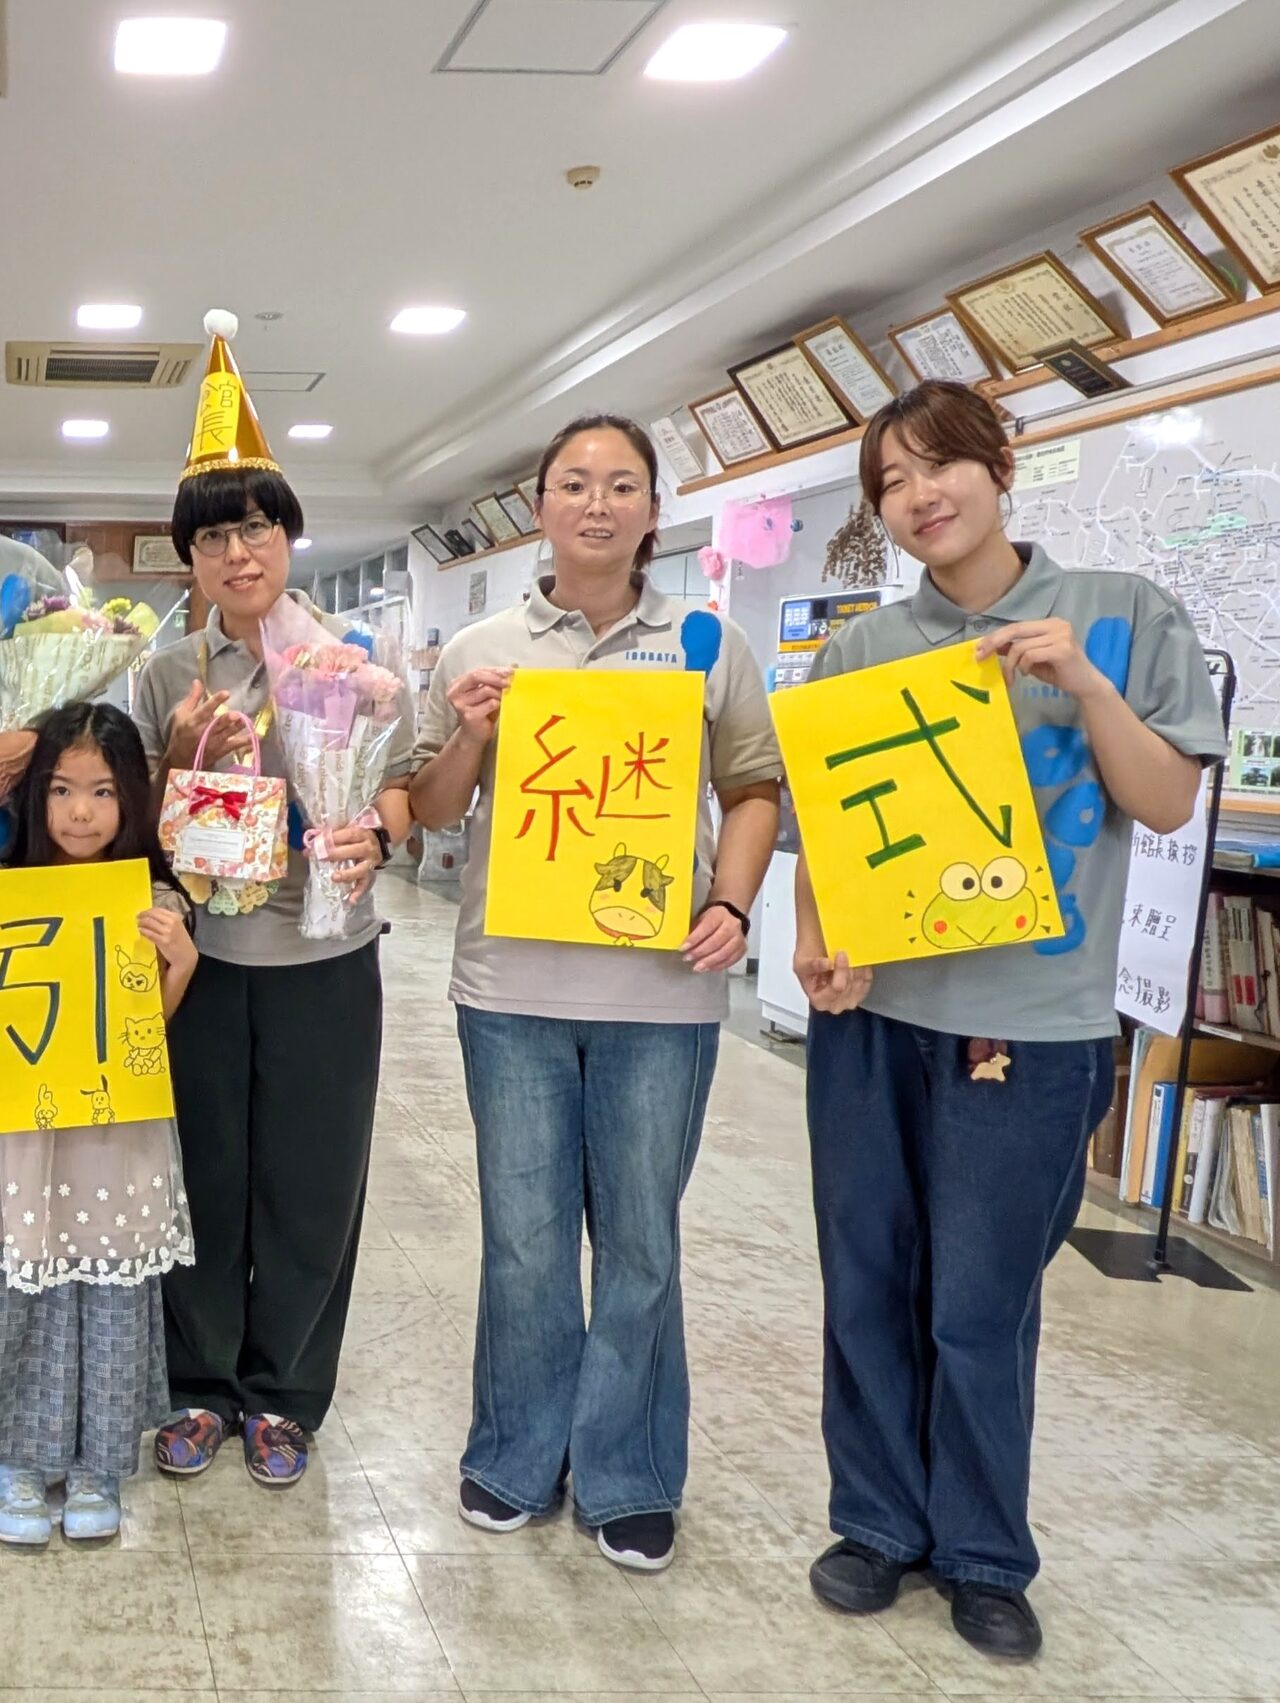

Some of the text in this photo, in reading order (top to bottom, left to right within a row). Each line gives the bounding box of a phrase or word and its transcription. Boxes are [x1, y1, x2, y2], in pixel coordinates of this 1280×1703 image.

[514, 714, 673, 862] 継
[825, 679, 1013, 870] 式
[1122, 903, 1177, 942] 束贈呈
